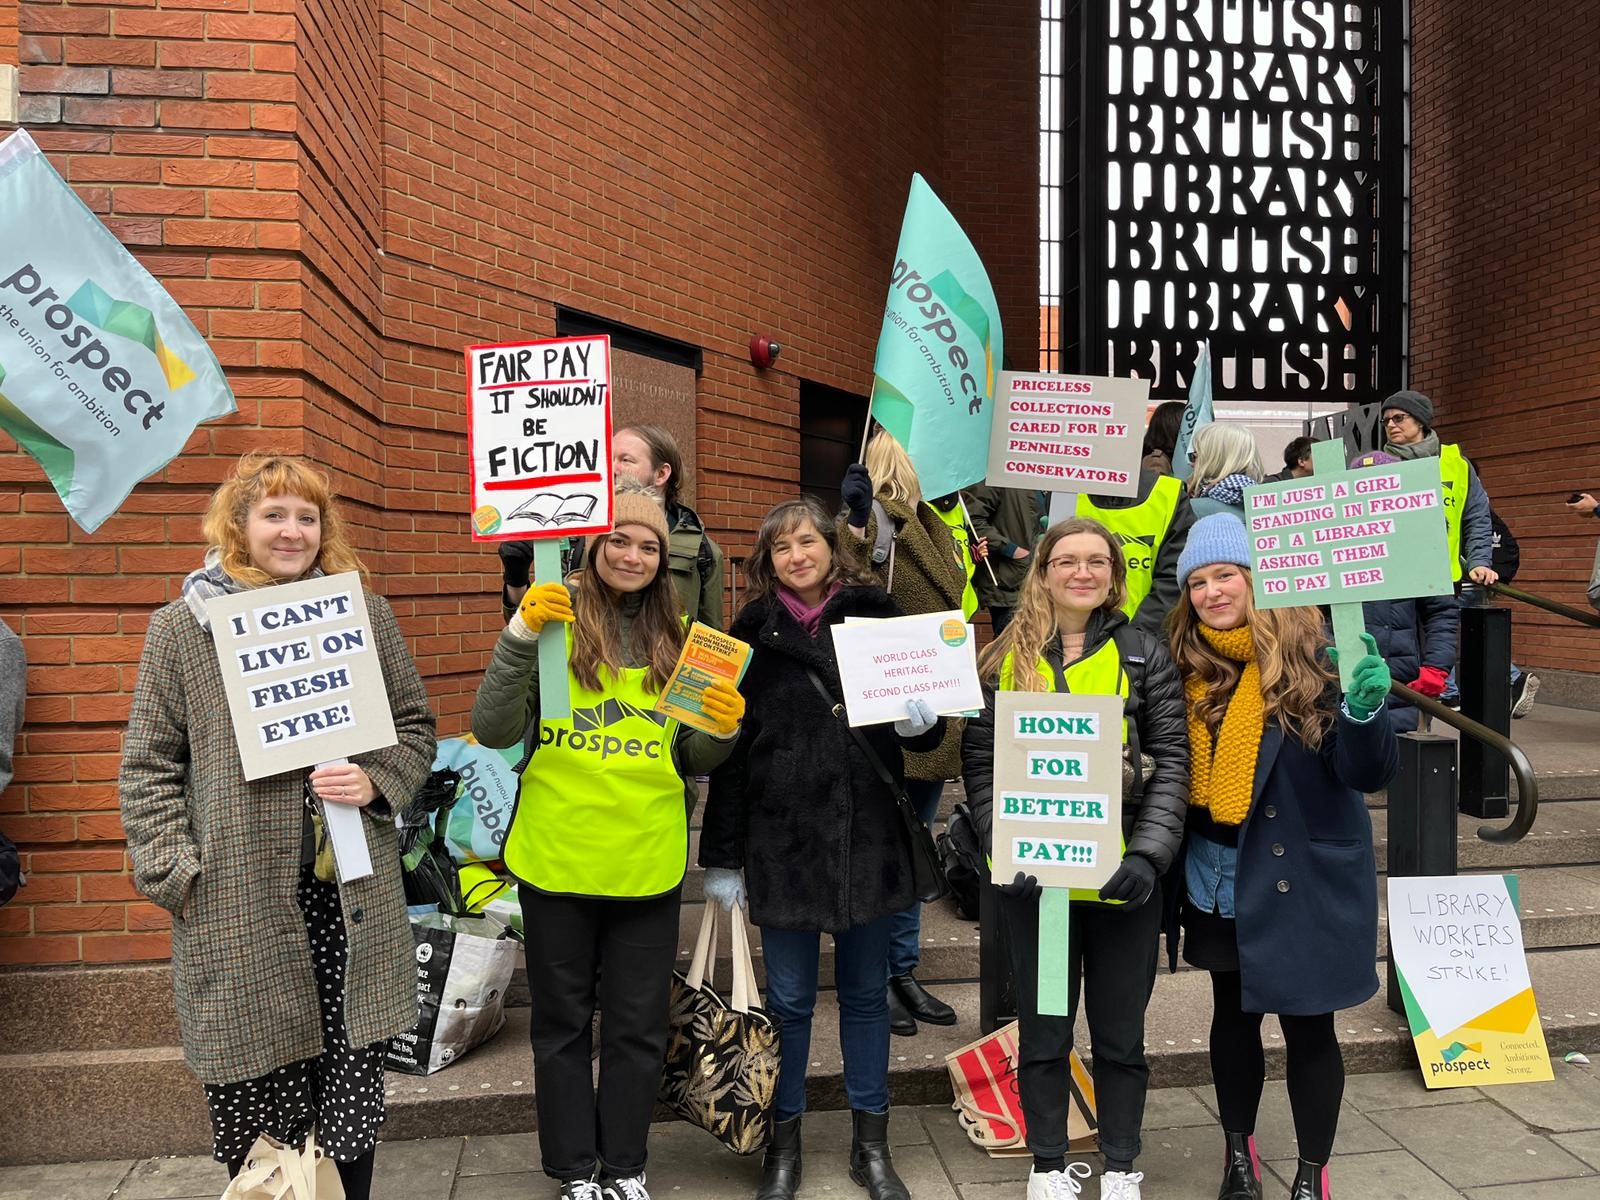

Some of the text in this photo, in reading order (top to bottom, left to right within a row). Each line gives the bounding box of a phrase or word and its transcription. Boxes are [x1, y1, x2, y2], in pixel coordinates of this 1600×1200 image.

[1110, 0, 1371, 50] BRITISH
[1112, 45, 1375, 105] LIBRARY
[1110, 103, 1371, 161] BRITISH
[1112, 161, 1375, 217] LIBRARY
[1110, 219, 1371, 275] BRITISH
[1112, 279, 1375, 333] LIBRARY
[0, 263, 165, 431] prospect
[891, 258, 982, 416] prospect
[0, 304, 121, 437] the union for ambition
[479, 350, 532, 384] FAIR
[905, 326, 922, 345] for
[920, 344, 955, 406] ambition
[1012, 379, 1091, 393] PRICELESS
[490, 390, 514, 414] IT
[1010, 401, 1111, 416] COLLECTIONS
[523, 418, 547, 436] BE
[1010, 421, 1126, 436] CARED FOR BY
[488, 439, 598, 477] FICTION
[1009, 440, 1090, 457] PENNILESS
[1006, 461, 1128, 483] CONSERVATORS
[1252, 476, 1400, 507] I'M JUST A GIRL
[1252, 506, 1334, 531] STANDING
[1343, 503, 1362, 518] IN
[1369, 492, 1435, 513] FRONT
[1256, 520, 1392, 550] OF A LIBRARY
[1259, 544, 1386, 571] ASKING THEM
[1264, 569, 1383, 593] TO PAY HER
[232, 595, 349, 635] I CAN'T
[694, 633, 713, 644] UNION
[239, 629, 364, 672] LIVE ON
[712, 646, 732, 657] STRIKE
[872, 648, 938, 664] WORLD CLASS
[680, 664, 691, 677] 2
[884, 664, 933, 678] HERITAGE,
[251, 668, 350, 708] FRESH
[671, 681, 683, 694] 3
[862, 678, 961, 700] SECOND CLASS PAY!!!
[261, 705, 351, 743] EYRE!
[1018, 717, 1095, 735] HONK
[540, 726, 664, 760] prospec
[1030, 758, 1083, 776] FOR
[1003, 797, 1104, 819] BETTER
[1017, 841, 1092, 863] PAY!!!
[1407, 892, 1508, 918] LIBRARY
[1413, 924, 1514, 946] WORKERS
[1449, 949, 1475, 959] ON
[1426, 964, 1510, 982] STRIKE!
[1500, 1041, 1540, 1050] Connected.
[1431, 1058, 1490, 1076] prospect
[1504, 1054, 1542, 1063] Ambitious.
[1506, 1066, 1532, 1075] Strong.
